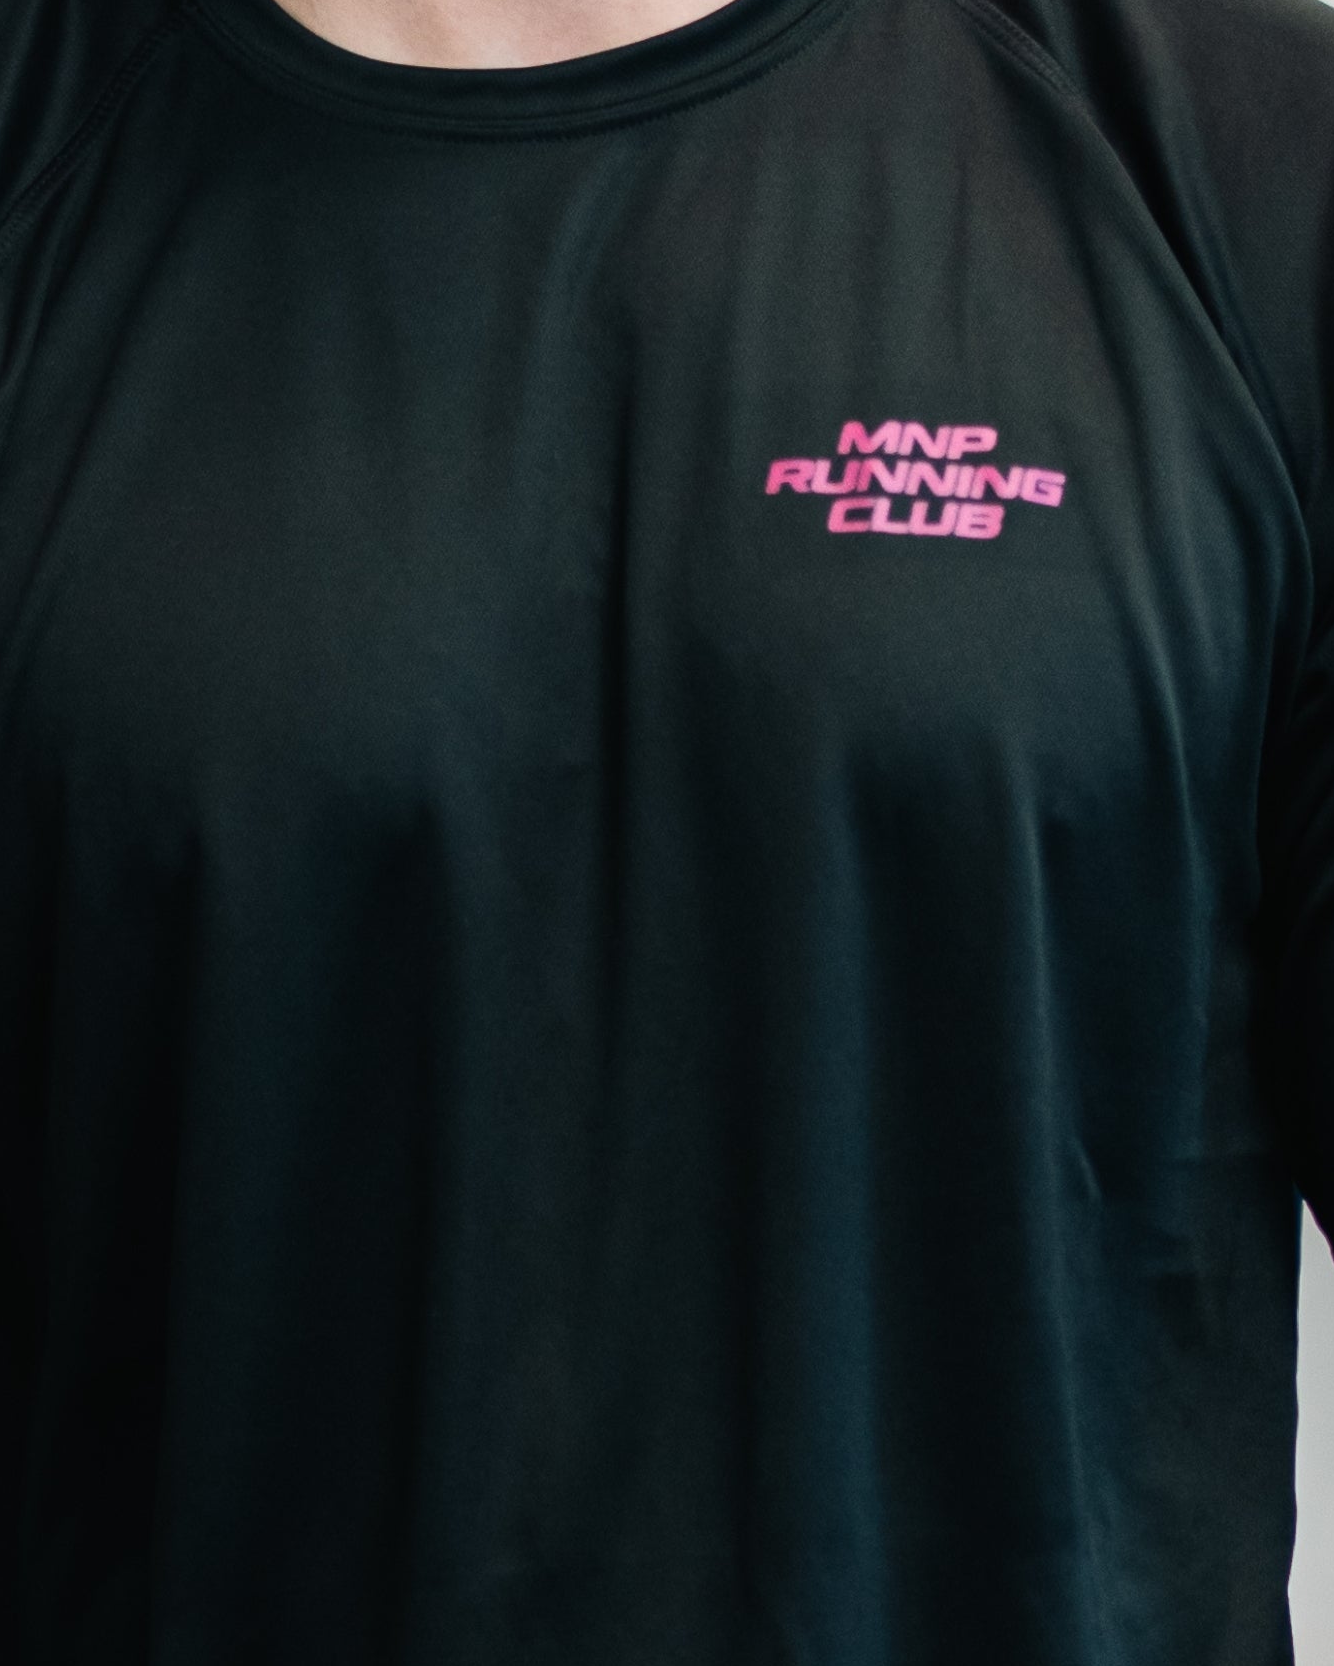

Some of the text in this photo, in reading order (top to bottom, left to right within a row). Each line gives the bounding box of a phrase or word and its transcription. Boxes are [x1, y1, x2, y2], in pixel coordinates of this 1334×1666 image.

[837, 420, 998, 460] MNP
[765, 458, 1065, 507] RUNNING
[827, 497, 1005, 539] CLUB
